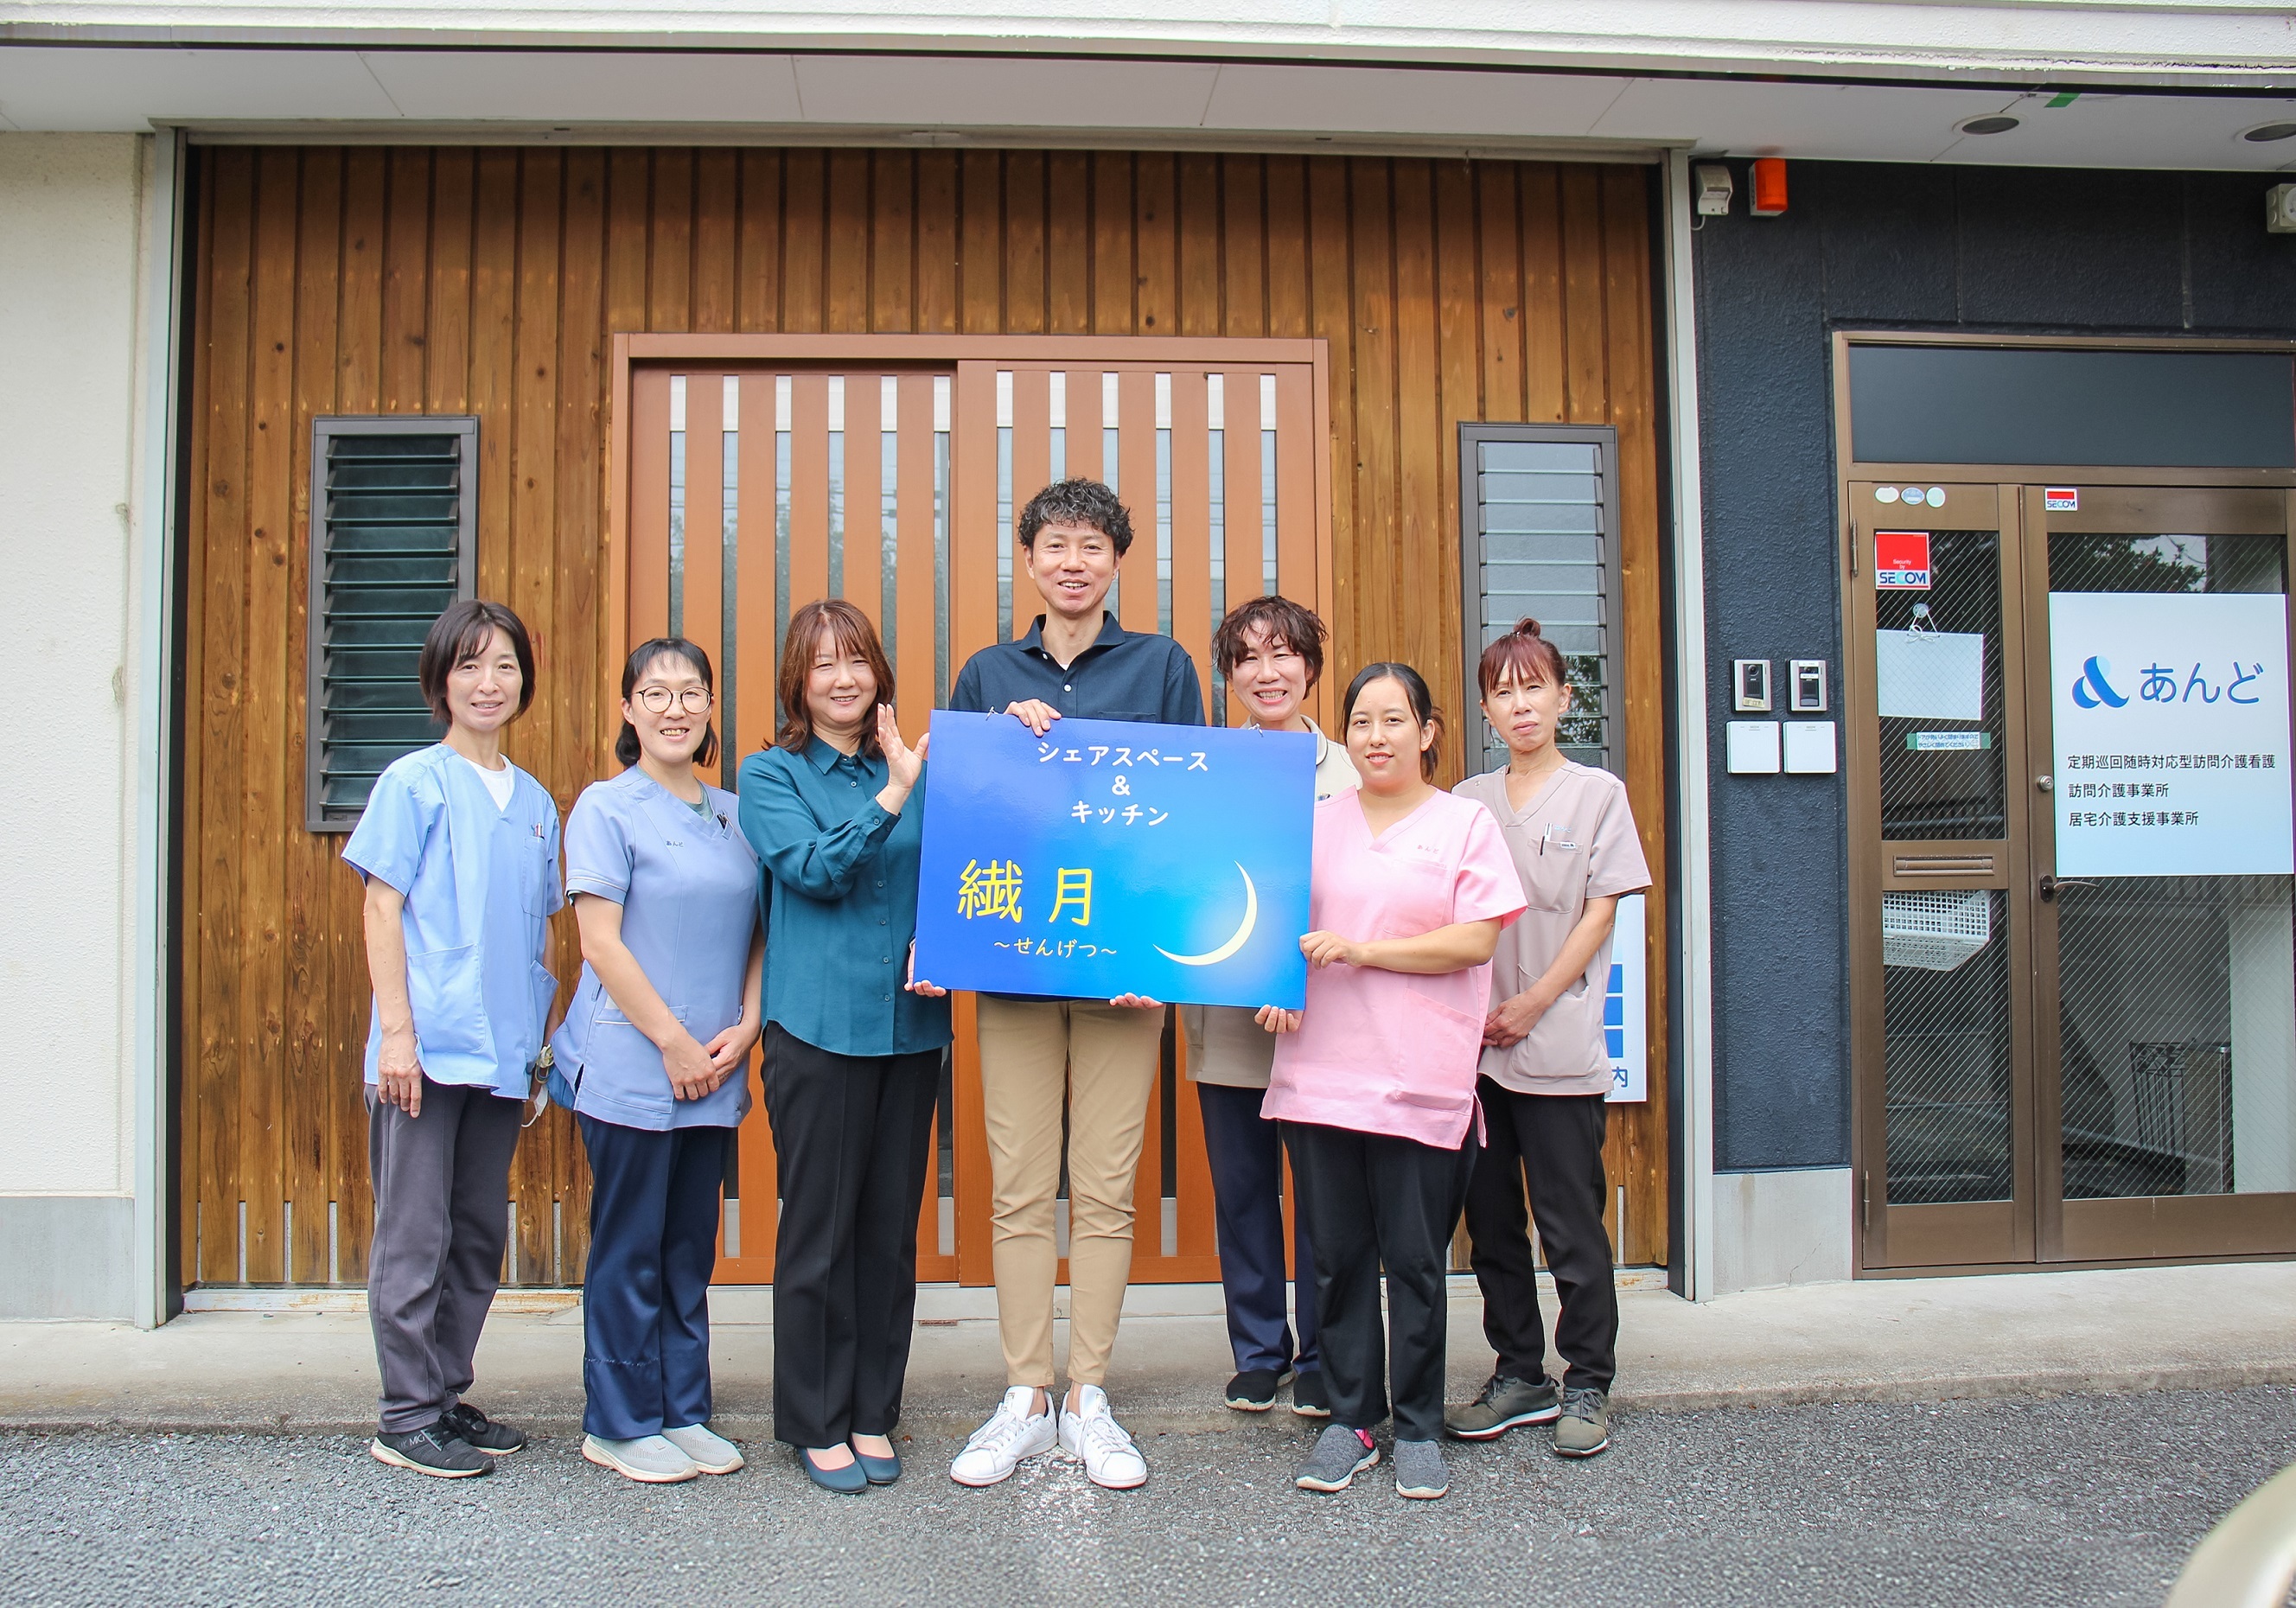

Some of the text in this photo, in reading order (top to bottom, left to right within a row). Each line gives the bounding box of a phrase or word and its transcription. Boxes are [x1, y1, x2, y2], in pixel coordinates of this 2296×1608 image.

[2046, 500, 2076, 508] SECOM
[1879, 571, 1926, 584] SECOM
[2140, 660, 2263, 705] あんど
[1036, 741, 1209, 773] シェアスペース
[2067, 754, 2276, 769] 定期巡回随時対応型訪問介護看護
[1111, 775, 1132, 796] &
[2068, 783, 2170, 798] 訪問介護事業所
[1070, 800, 1170, 827] キッチン
[2069, 811, 2199, 826] 居宅介護支援事業所
